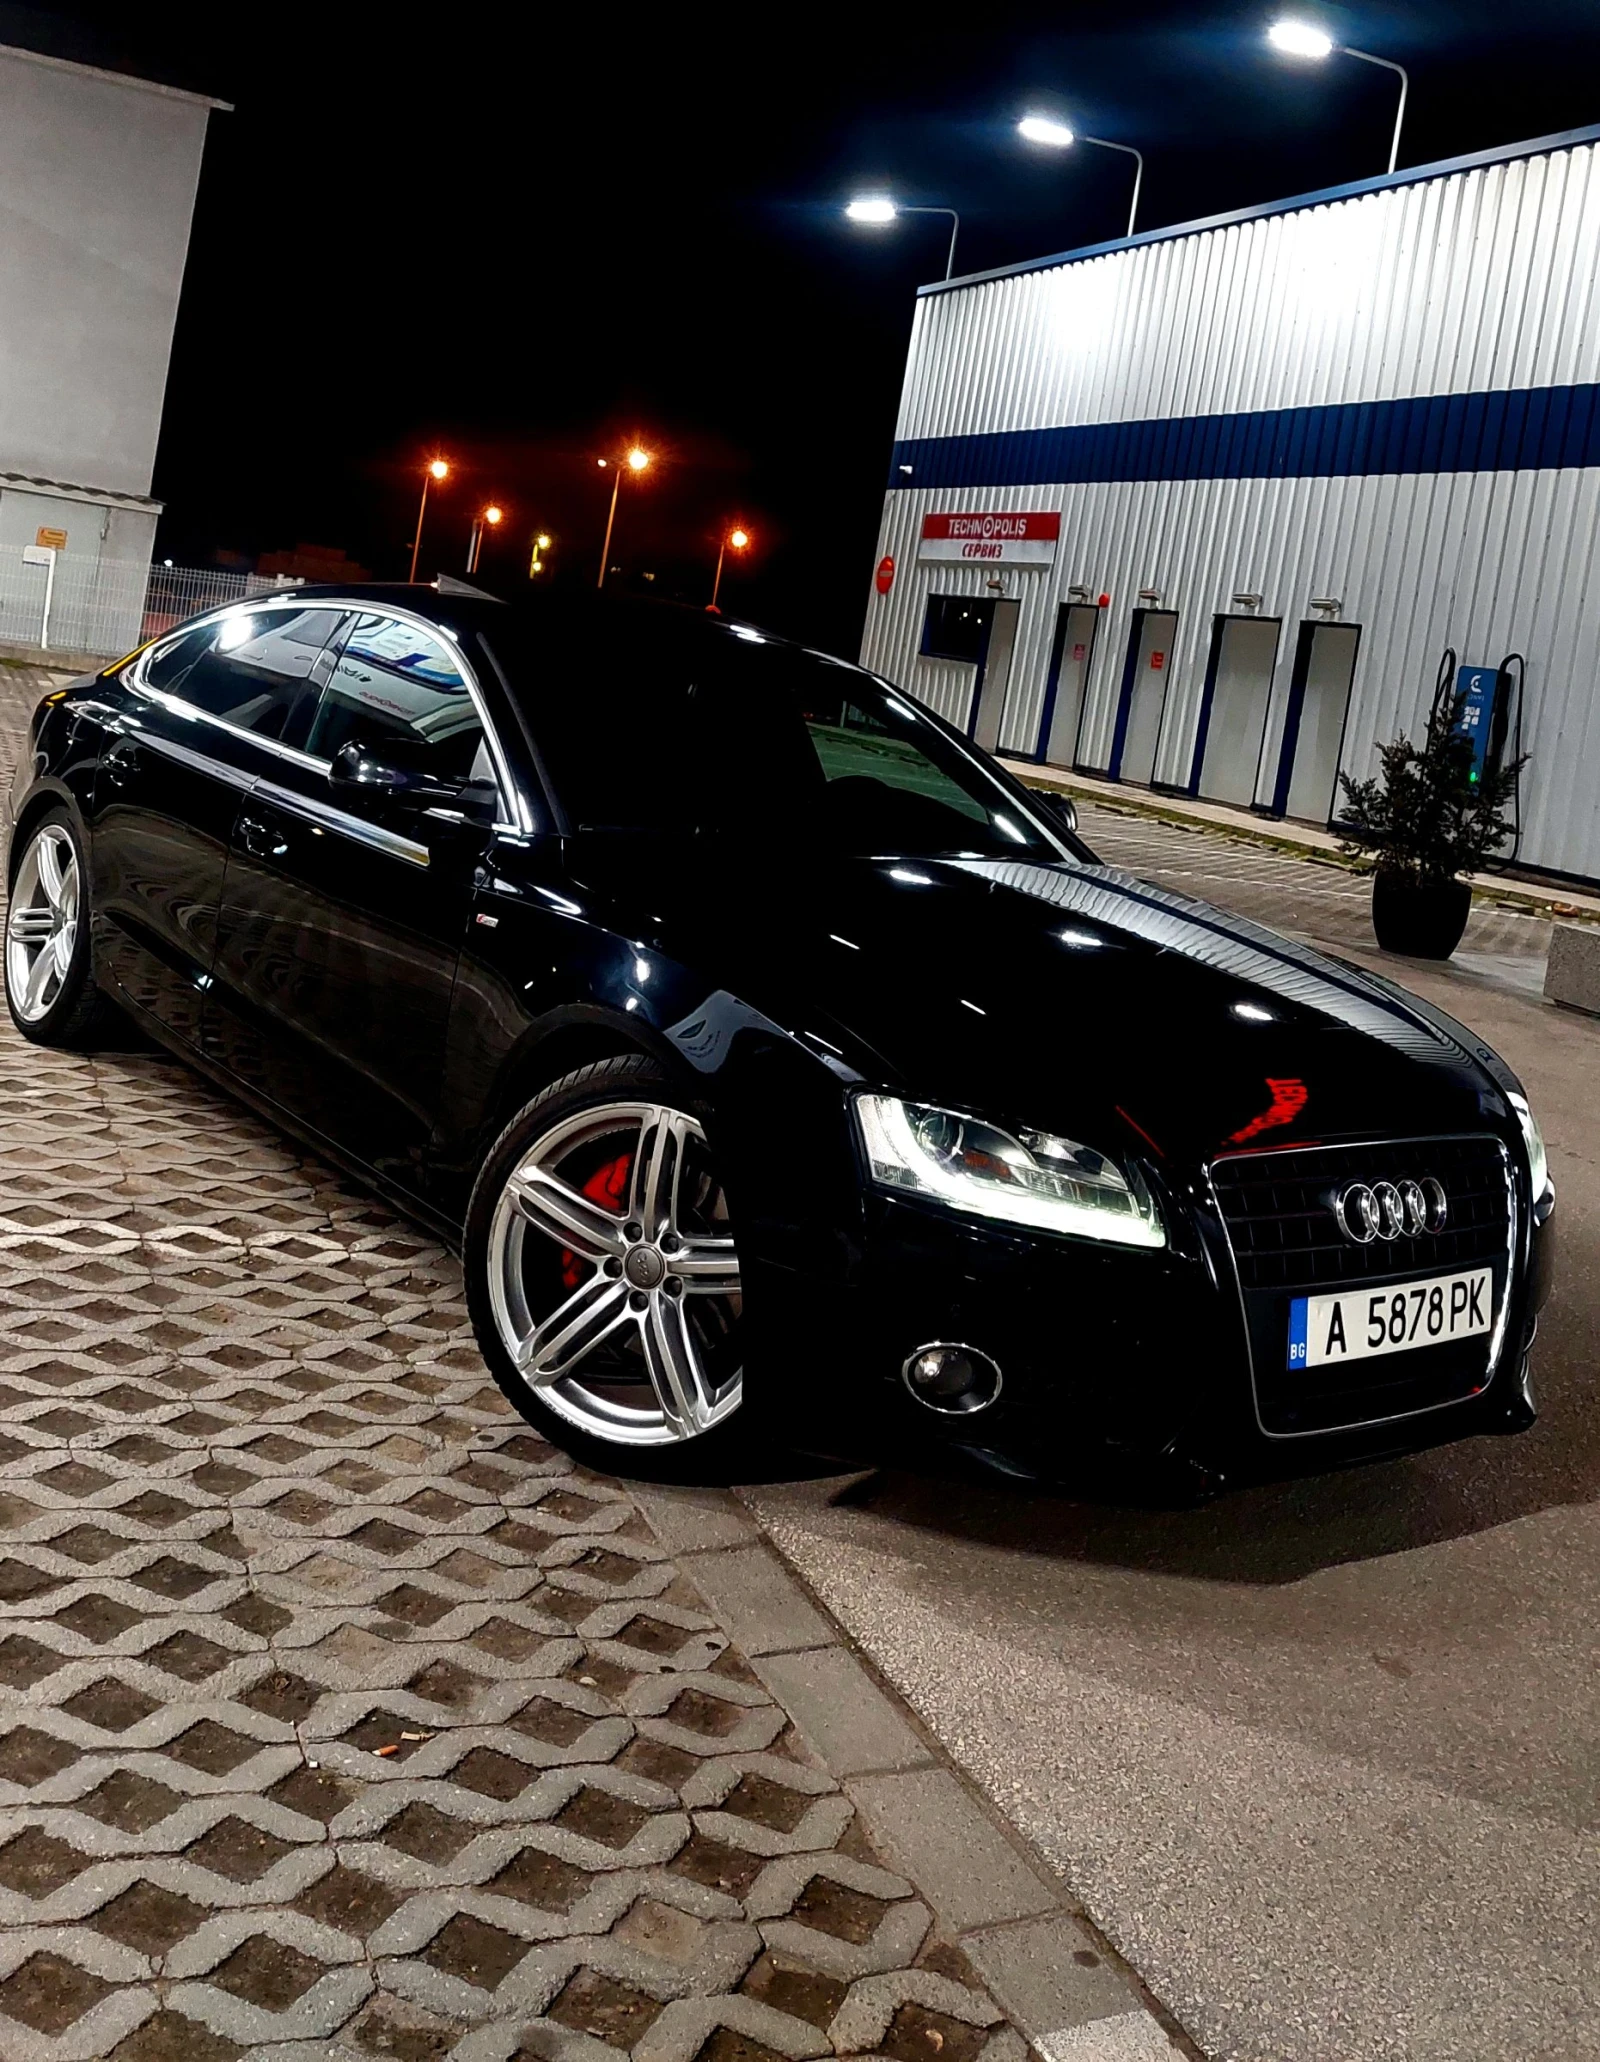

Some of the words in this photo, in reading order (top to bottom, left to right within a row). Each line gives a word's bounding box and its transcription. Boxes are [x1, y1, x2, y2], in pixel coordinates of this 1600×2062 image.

[949, 515, 1027, 537] TECHNOPOLIS
[962, 543, 1003, 558] СЕРВИЗ
[1325, 1301, 1347, 1356] A
[1290, 1342, 1306, 1360] BG
